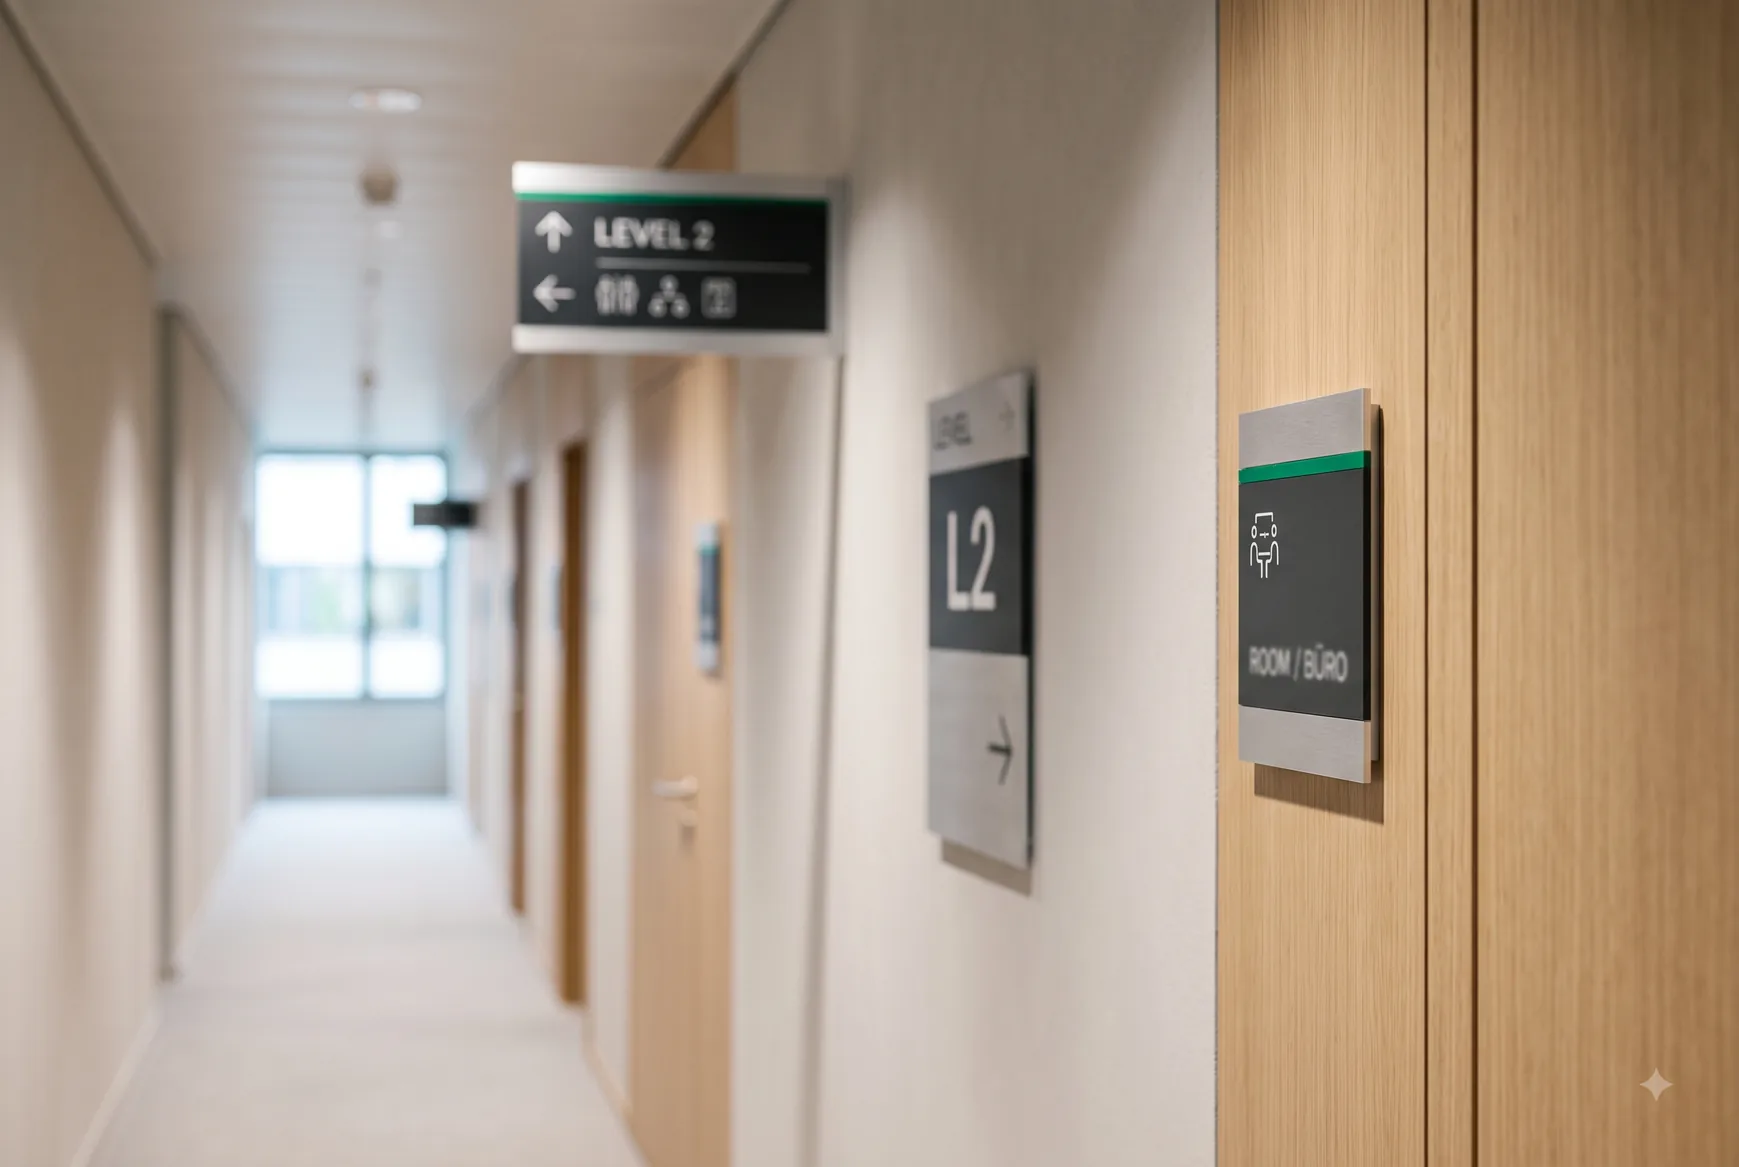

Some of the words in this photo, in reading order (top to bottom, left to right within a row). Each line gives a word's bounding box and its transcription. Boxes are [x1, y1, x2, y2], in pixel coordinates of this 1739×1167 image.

[593, 216, 690, 250] LEVEL
[691, 219, 716, 251] 2
[946, 505, 997, 611] L2
[1249, 646, 1291, 677] ROOM
[1293, 646, 1302, 682] /
[1303, 641, 1348, 683] BÜRO
